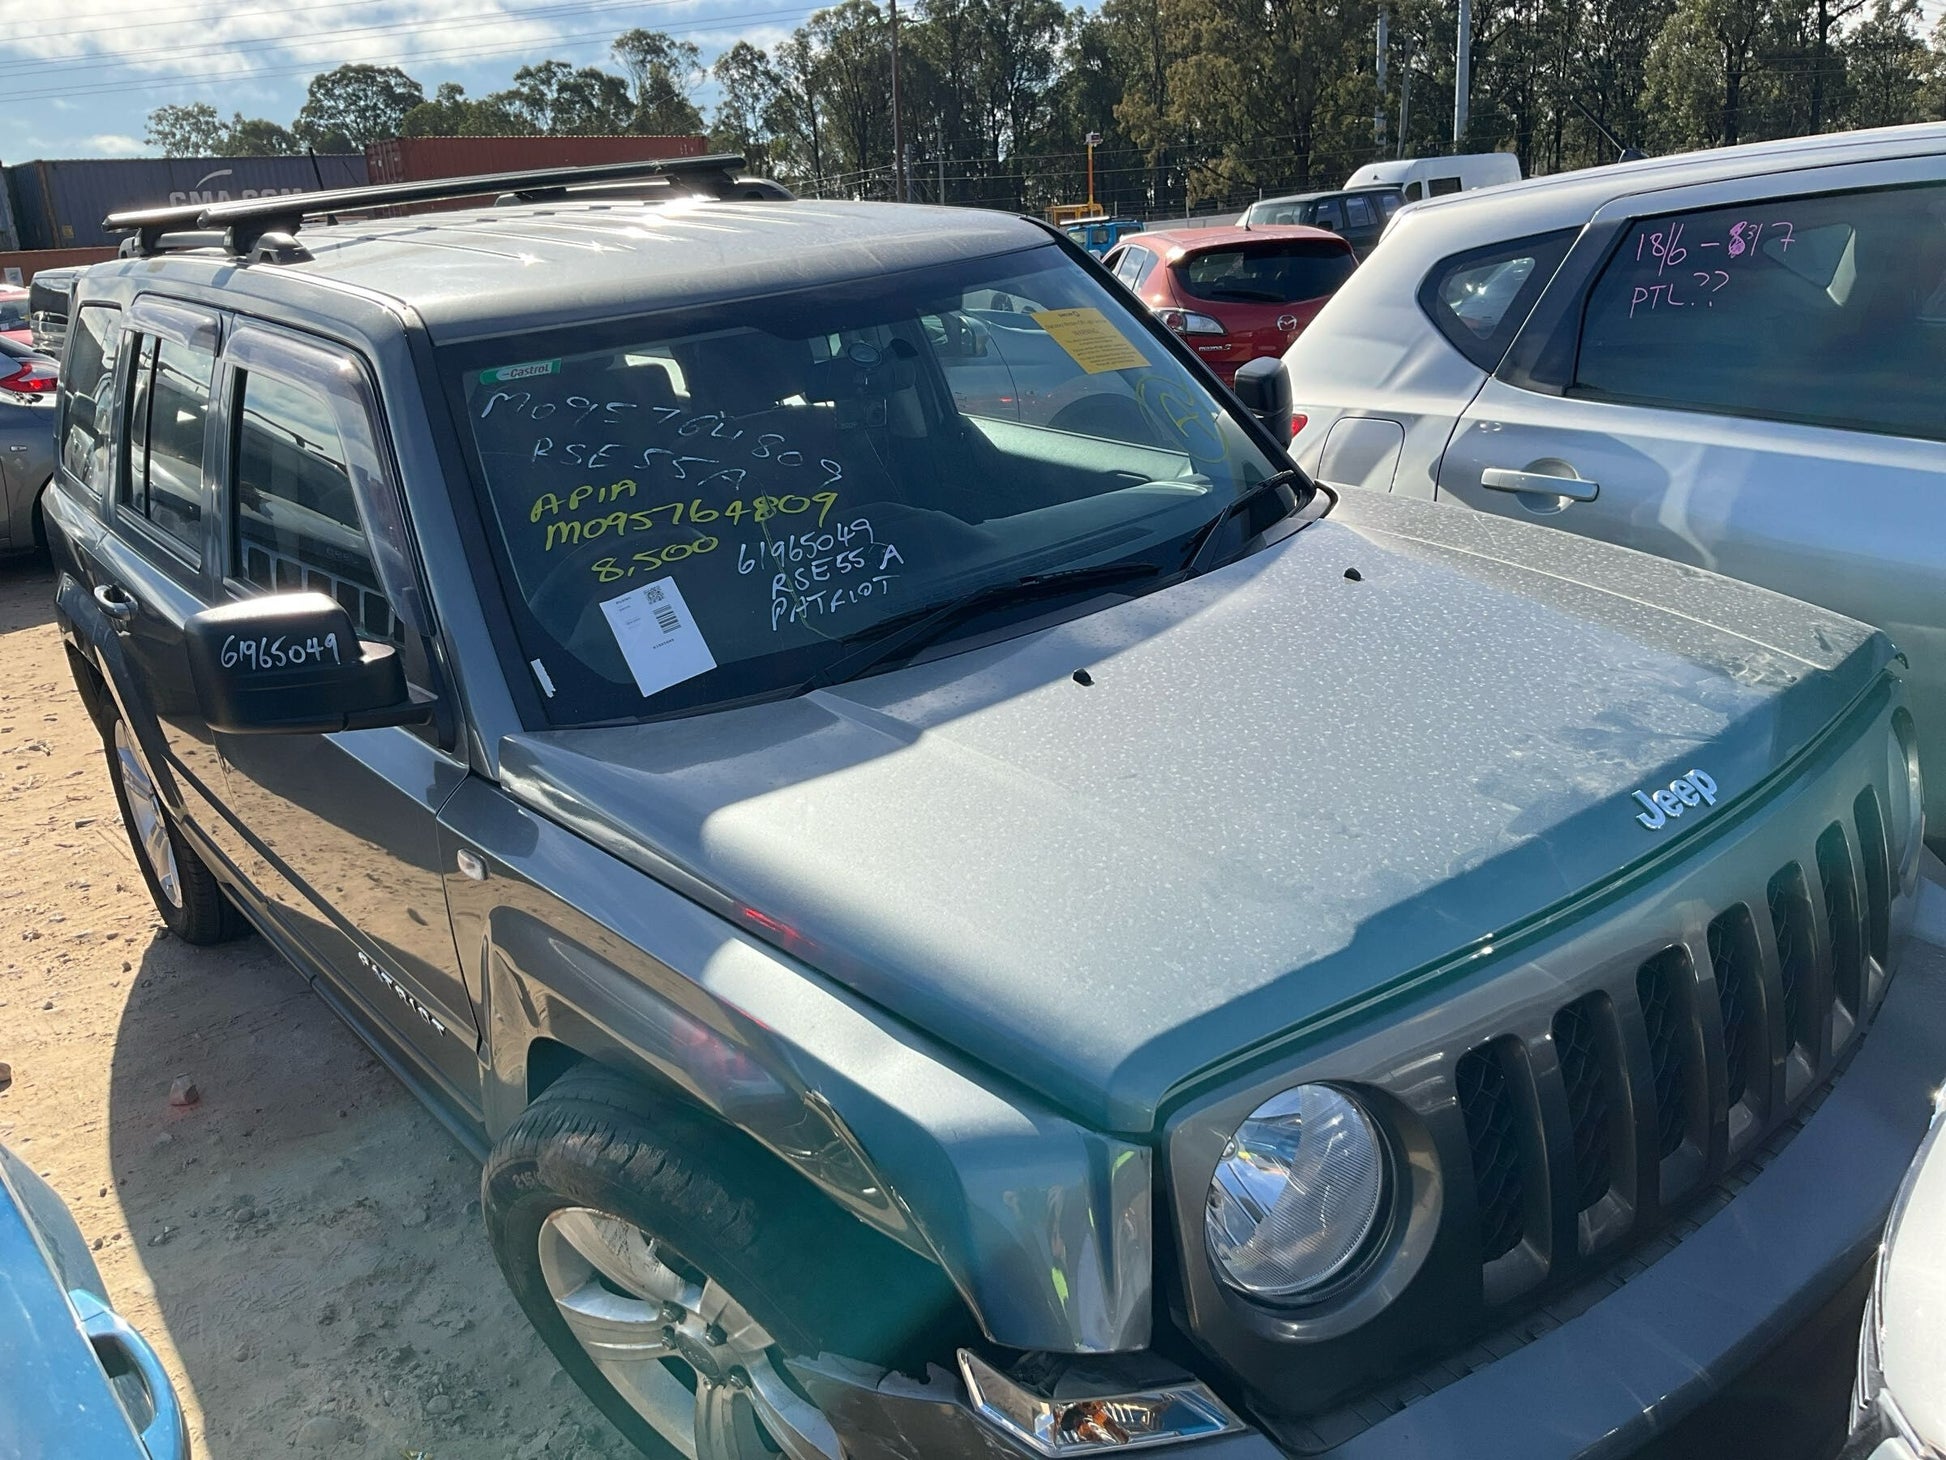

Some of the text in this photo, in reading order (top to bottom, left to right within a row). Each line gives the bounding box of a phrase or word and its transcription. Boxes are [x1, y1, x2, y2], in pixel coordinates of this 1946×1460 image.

[510, 363, 550, 378] Castrol
[737, 518, 874, 575] 61965049
[220, 632, 341, 670] 61965049
[1631, 768, 1718, 830] Jeep
